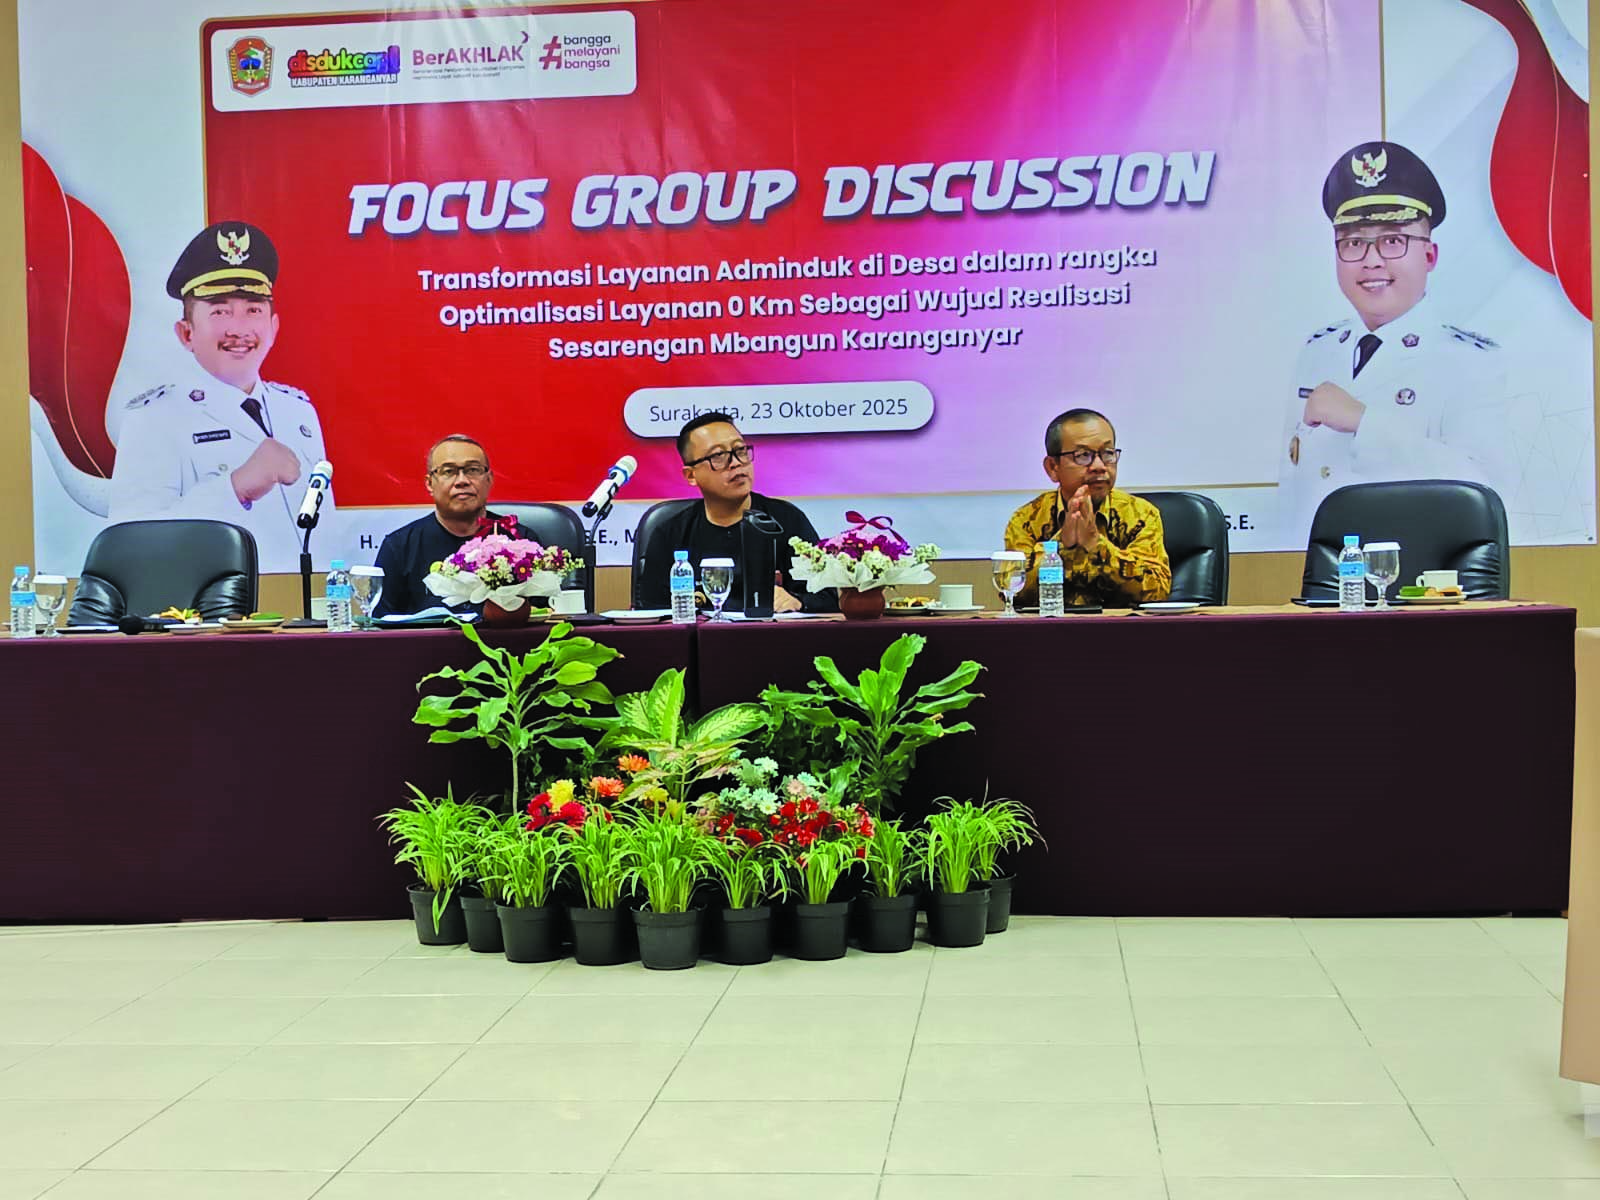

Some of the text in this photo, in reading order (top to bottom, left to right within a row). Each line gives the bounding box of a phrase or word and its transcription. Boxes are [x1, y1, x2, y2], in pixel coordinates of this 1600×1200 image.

[563, 35, 611, 47] bangga
[412, 45, 524, 66] BerAKHLAK
[564, 44, 620, 58] melayani
[564, 59, 610, 71] bangsa
[291, 73, 398, 87] KABUPATEN KARANGANYAR
[348, 151, 1216, 234] FOCUS GROUP DISCUSSION
[418, 245, 1156, 290] Transformasi Layanan Adminduk di Desa dalam rangka
[439, 282, 1130, 331] Optimalisasi Layanan 0 Km Sebagai Wujud Realisasi
[549, 326, 1023, 362] Sesarengan Mbangun Karanganyar
[751, 402, 773, 419] 23
[779, 400, 856, 418] Oktober
[862, 398, 908, 416] 2025
[1223, 514, 1254, 530] S.E.
[361, 535, 378, 549] H.
